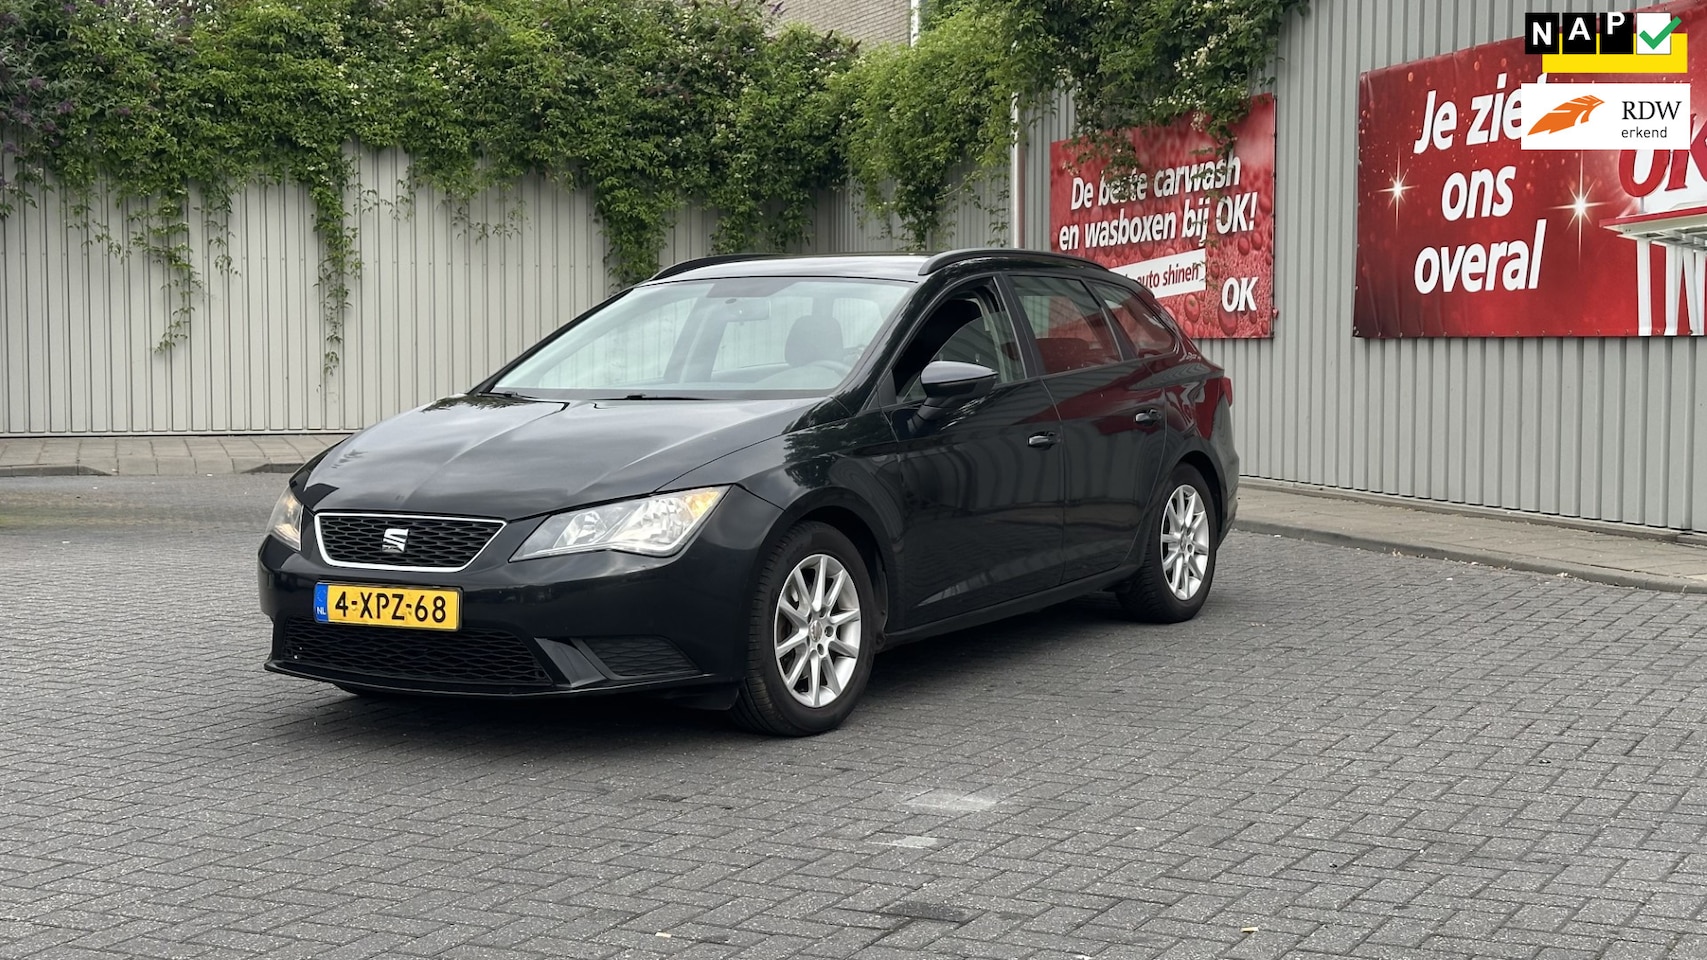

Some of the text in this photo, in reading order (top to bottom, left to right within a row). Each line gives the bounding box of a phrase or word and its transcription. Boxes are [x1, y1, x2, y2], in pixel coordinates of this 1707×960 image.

[1413, 73, 1547, 154] Je zie
[1071, 151, 1241, 211] De bete carwash
[1441, 165, 1516, 222] ons
[1059, 192, 1258, 251] en wasboxen bij OK!
[1162, 262, 1200, 287] shinen
[1413, 219, 1547, 295] overal
[1221, 276, 1259, 312] OK
[316, 591, 446, 623] NL 4-XPZ-68
